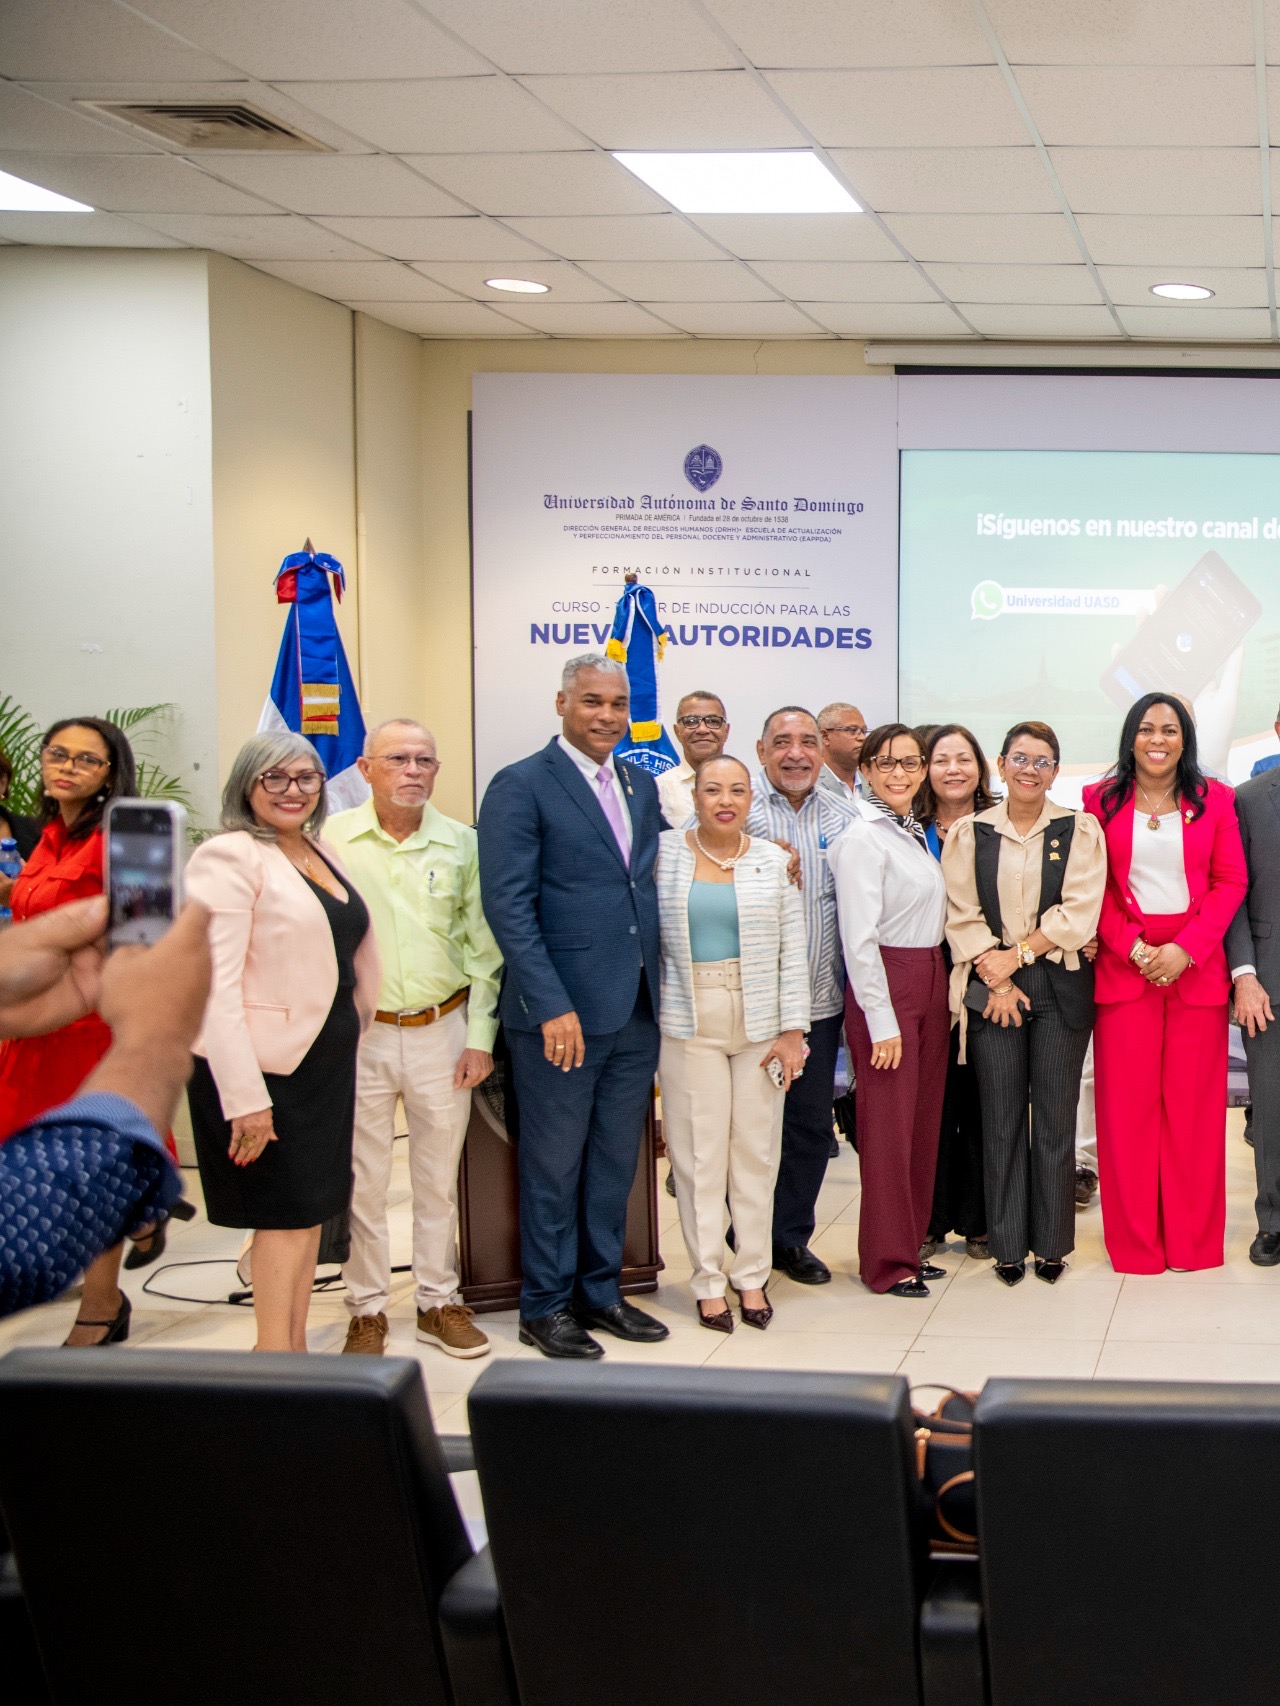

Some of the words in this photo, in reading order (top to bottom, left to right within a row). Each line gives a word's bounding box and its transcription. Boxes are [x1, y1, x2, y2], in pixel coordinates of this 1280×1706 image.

[543, 494, 635, 509] Universidad
[640, 494, 716, 510] Autónoma
[720, 497, 736, 511] de
[741, 496, 788, 512] Santo
[793, 497, 864, 515] Domingo
[653, 513, 680, 522] AMÉRICA
[1085, 518, 1111, 537] en
[1116, 517, 1198, 538] nuestro
[1202, 517, 1258, 539] canal
[592, 565, 681, 575] FORMACIÓN
[691, 567, 811, 577] INSTITUCIONAL
[551, 602, 600, 613] CURSO
[672, 602, 690, 613] DE
[695, 601, 776, 615] INDUCCIÓN
[780, 604, 819, 616] PARA
[823, 605, 851, 617] LAS
[1006, 595, 1081, 608] Universidad
[1084, 596, 1120, 609] UASD
[530, 623, 612, 645] NUEV
[662, 624, 873, 649] AUTORIDADES
